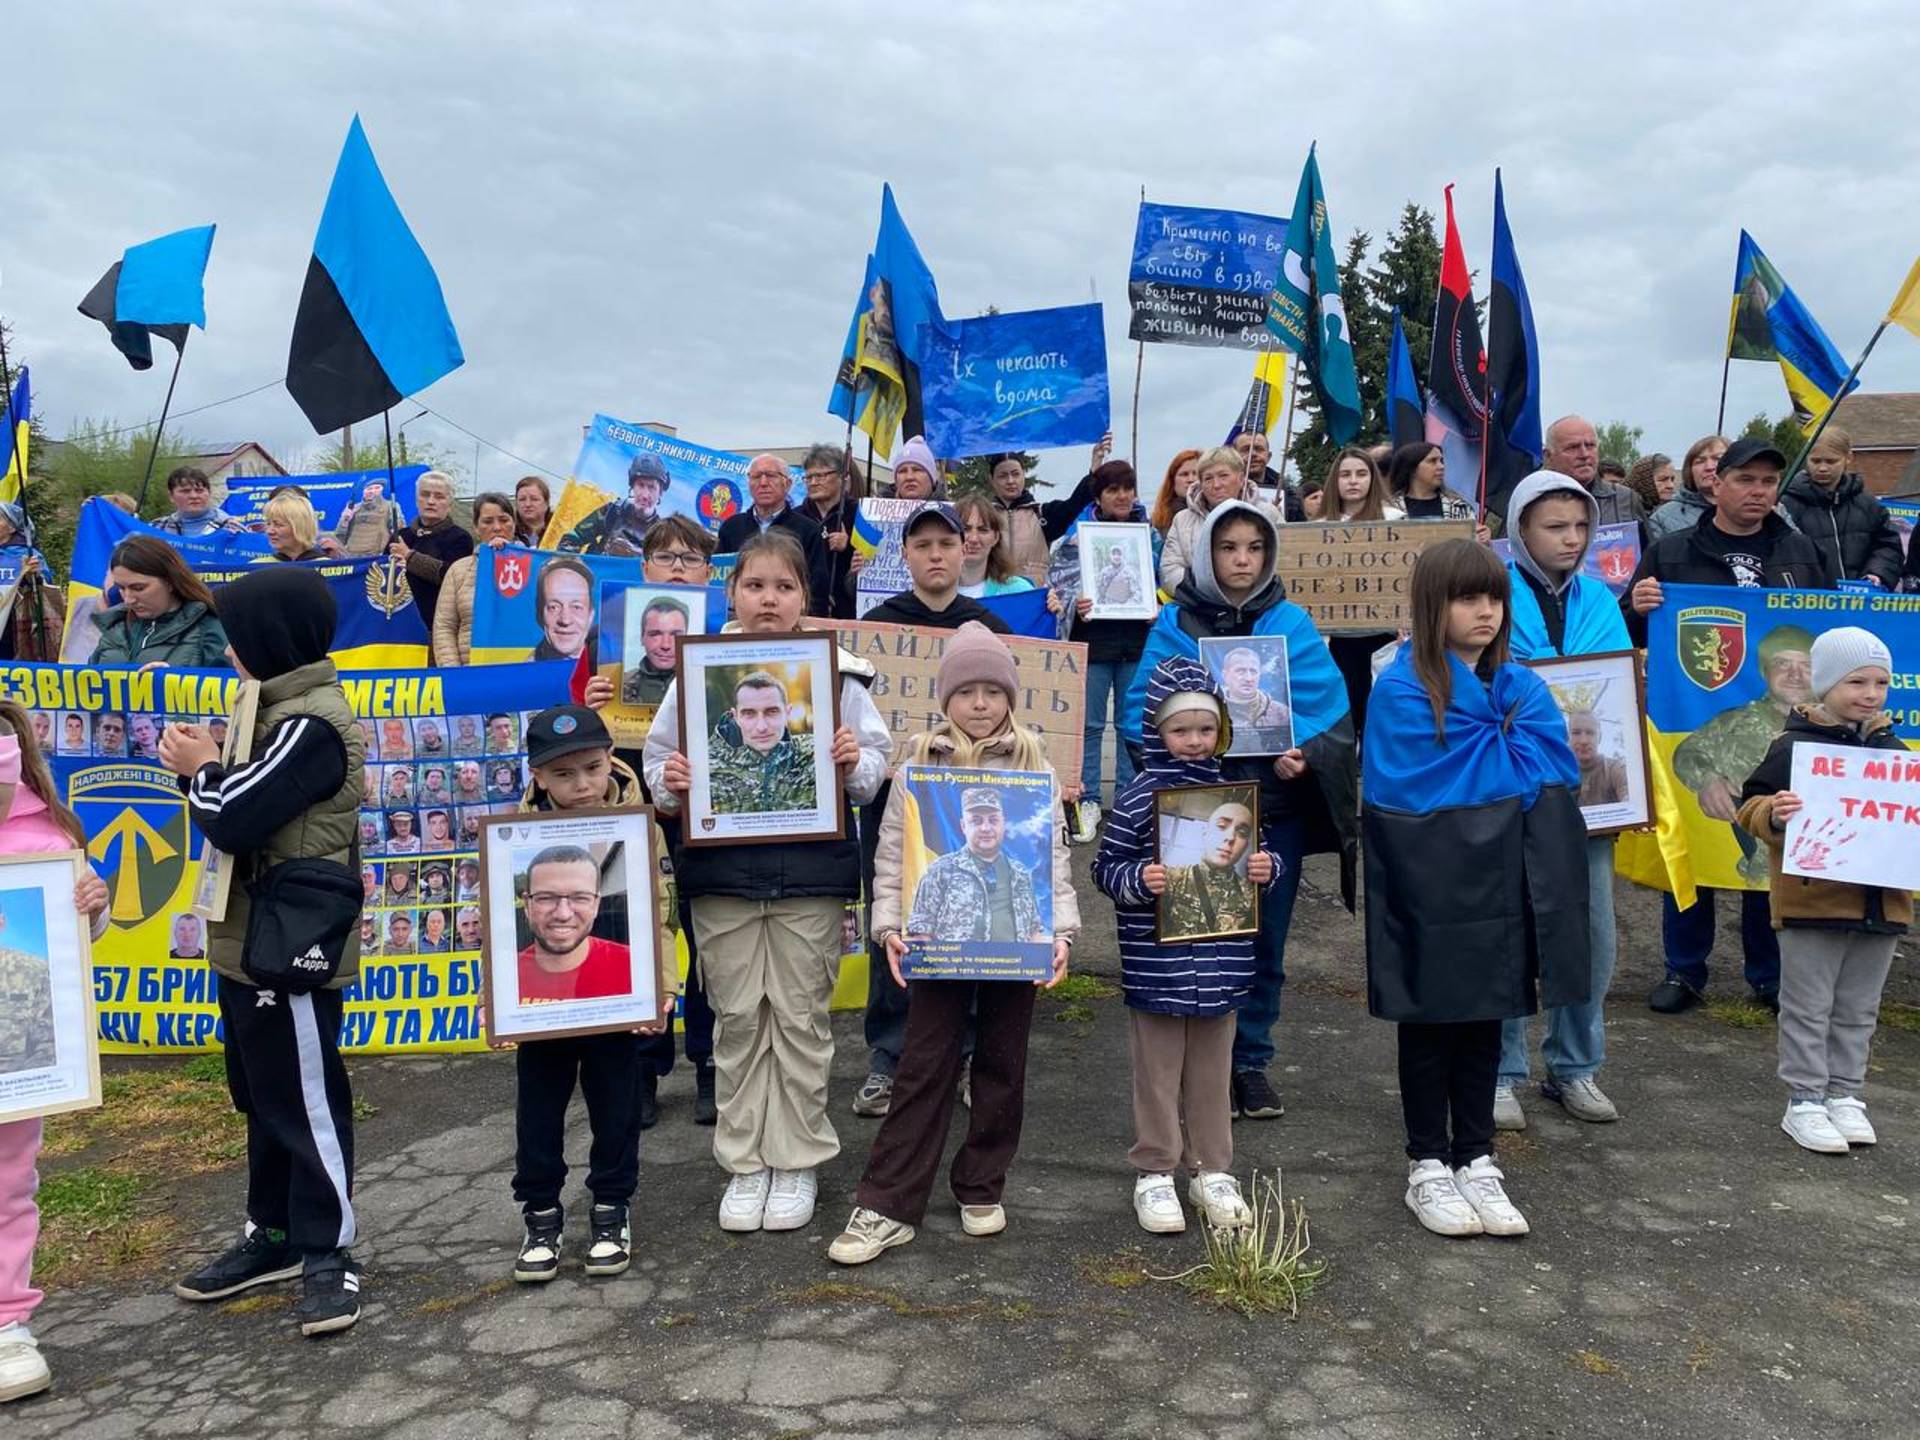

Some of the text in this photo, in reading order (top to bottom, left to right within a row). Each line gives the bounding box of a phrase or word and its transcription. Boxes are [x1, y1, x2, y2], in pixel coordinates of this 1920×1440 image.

[1162, 216, 1232, 242] Кричимо
[1237, 233, 1257, 246] на
[1172, 246, 1225, 263] світ і
[1146, 258, 1202, 279] биймо
[1215, 267, 1225, 283] в
[1136, 300, 1263, 323] полонені мають
[1213, 295, 1265, 311] зниклі
[996, 352, 1069, 374] чекають
[995, 379, 1057, 414] вдома
[607, 424, 655, 450] БЕЗВІСТИ
[1322, 527, 1400, 544] БУТЬ
[1767, 593, 1865, 611] БЕЗВІСТИ
[1039, 649, 1079, 674] ТА
[1890, 673, 1920, 690] СЕ
[1811, 757, 1846, 778] ДЕ
[74, 770, 179, 790] НАРОДЖЕНІ В БОЯ
[944, 772, 981, 786] Руслан
[1839, 797, 1920, 825] ТАТК
[292, 956, 329, 971] Kappa
[98, 1011, 150, 1047] КУ,
[384, 1008, 421, 1045] ТА
